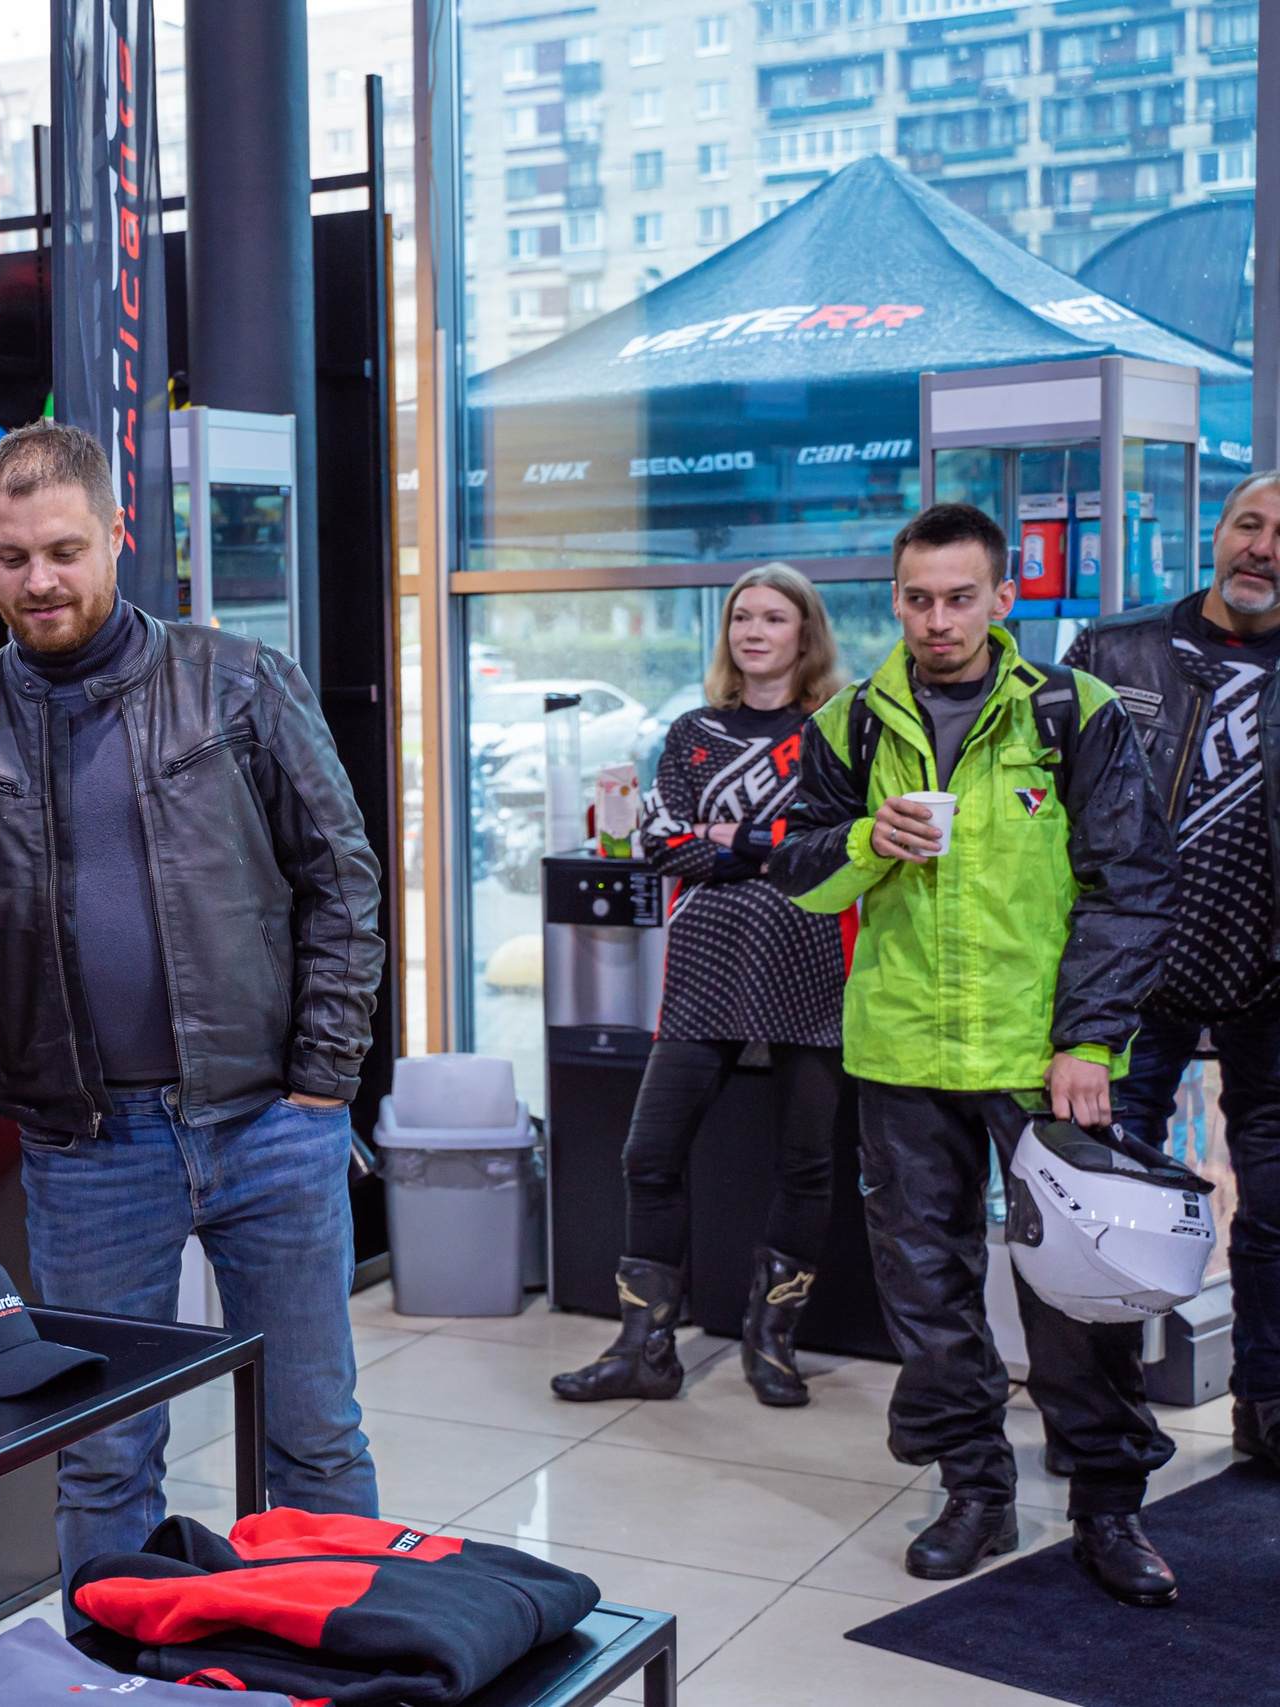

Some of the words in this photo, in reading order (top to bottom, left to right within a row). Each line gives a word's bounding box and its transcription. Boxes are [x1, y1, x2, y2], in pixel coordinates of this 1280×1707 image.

[616, 304, 925, 358] VETERR
[797, 438, 913, 465] can-am
[522, 459, 591, 485] LYNX
